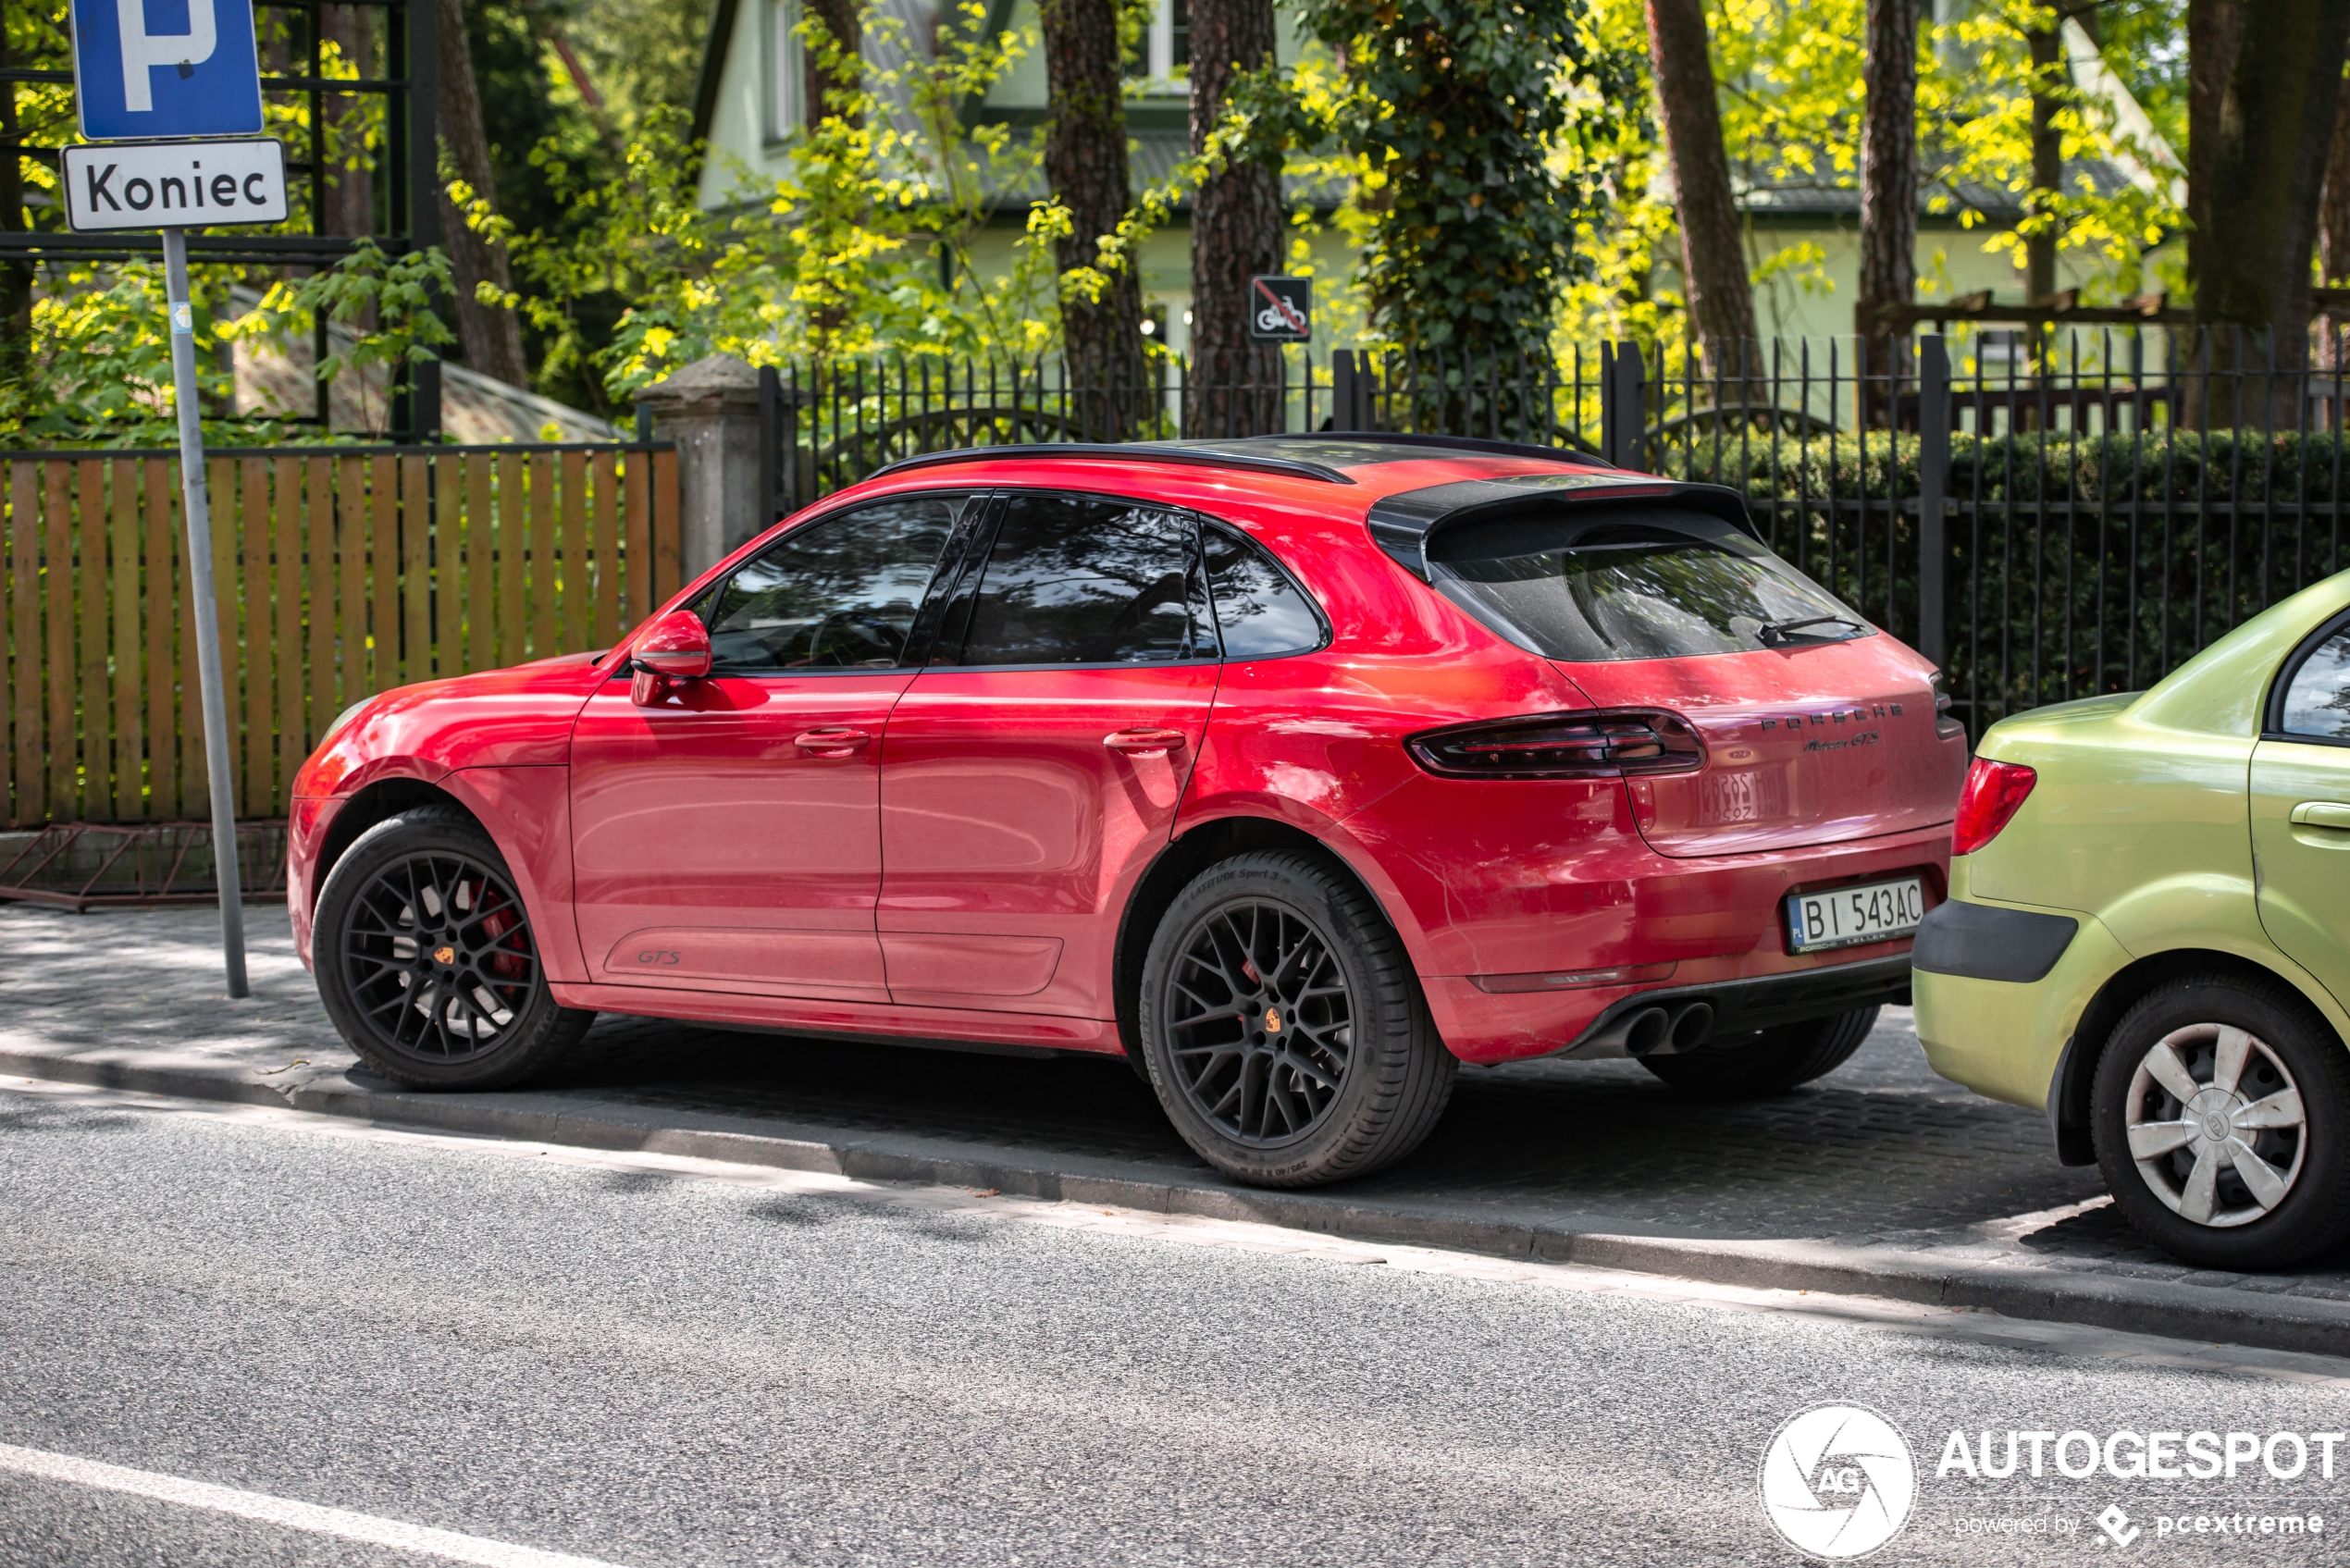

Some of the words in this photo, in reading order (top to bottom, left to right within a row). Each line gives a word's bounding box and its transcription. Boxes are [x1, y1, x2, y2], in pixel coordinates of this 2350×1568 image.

[118, 0, 216, 111] P
[87, 160, 267, 212] Koniec
[1762, 705, 1903, 731] PORSCHE
[1804, 738, 1849, 752] Macan
[1850, 730, 1879, 746] GTS
[1188, 870, 1237, 902] LATITUDE
[1237, 868, 1269, 881] Sport
[1269, 871, 1279, 881] 3
[1805, 897, 1839, 940] BI
[1852, 884, 1922, 932] 543AC
[1793, 928, 1802, 939] PL
[1800, 941, 1837, 953] PORSCHE
[1847, 933, 1886, 945] LELLEK
[637, 950, 681, 964] GTS
[1144, 1003, 1163, 1085] MICHELIN
[1250, 1167, 1264, 1177] 20
[1273, 1157, 1309, 1177] 295/40
